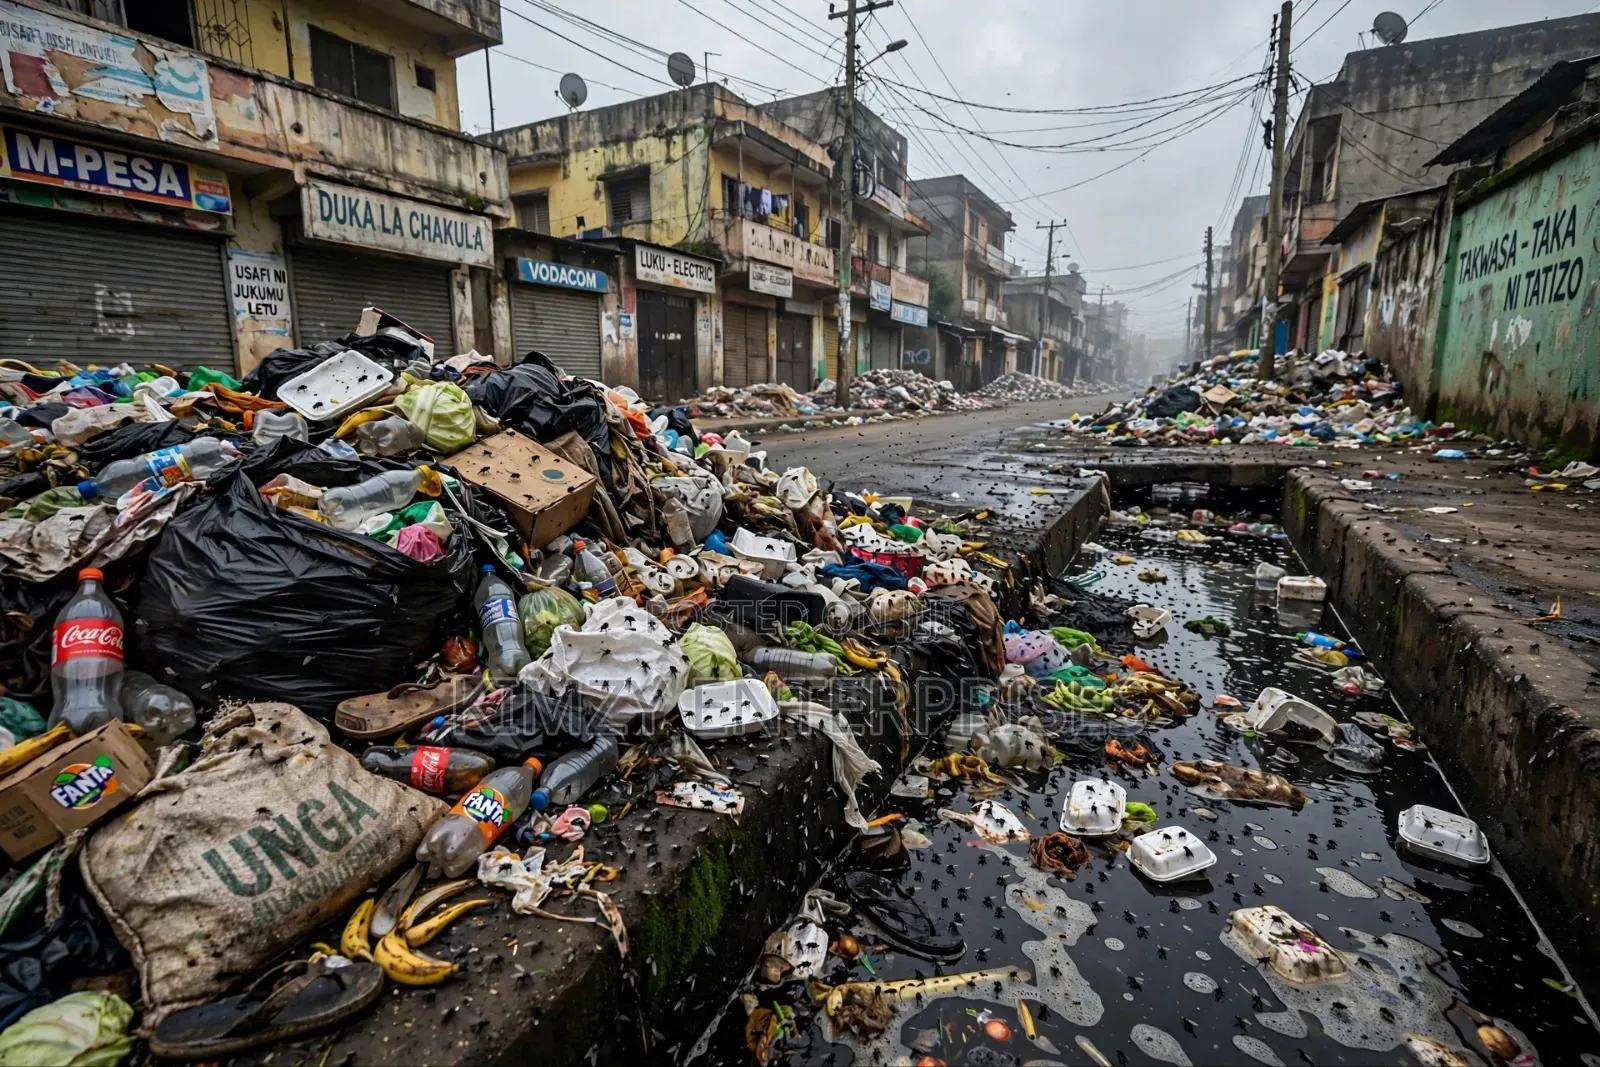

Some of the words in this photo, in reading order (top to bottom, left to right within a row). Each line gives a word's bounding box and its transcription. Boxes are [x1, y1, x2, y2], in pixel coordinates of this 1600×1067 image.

[15, 132, 184, 198] M-PESA
[318, 189, 376, 231] DUKA
[380, 203, 404, 237] LA
[409, 211, 484, 251] CHAKULA
[1458, 229, 1518, 285] TAKWASA
[1531, 204, 1577, 260] TAKA
[235, 264, 271, 282] USAFI
[273, 270, 286, 284] NI
[528, 261, 597, 289] VODACOM
[640, 250, 665, 272] LUKU
[674, 258, 713, 282] ELECTRIC
[1503, 274, 1522, 312] NI
[1524, 256, 1584, 308] TATIZO
[234, 284, 284, 302] JUKUMU
[247, 303, 278, 316] LETU
[50, 765, 114, 807] FANTA
[463, 792, 504, 827] FANTA
[201, 779, 380, 897] UNGA
